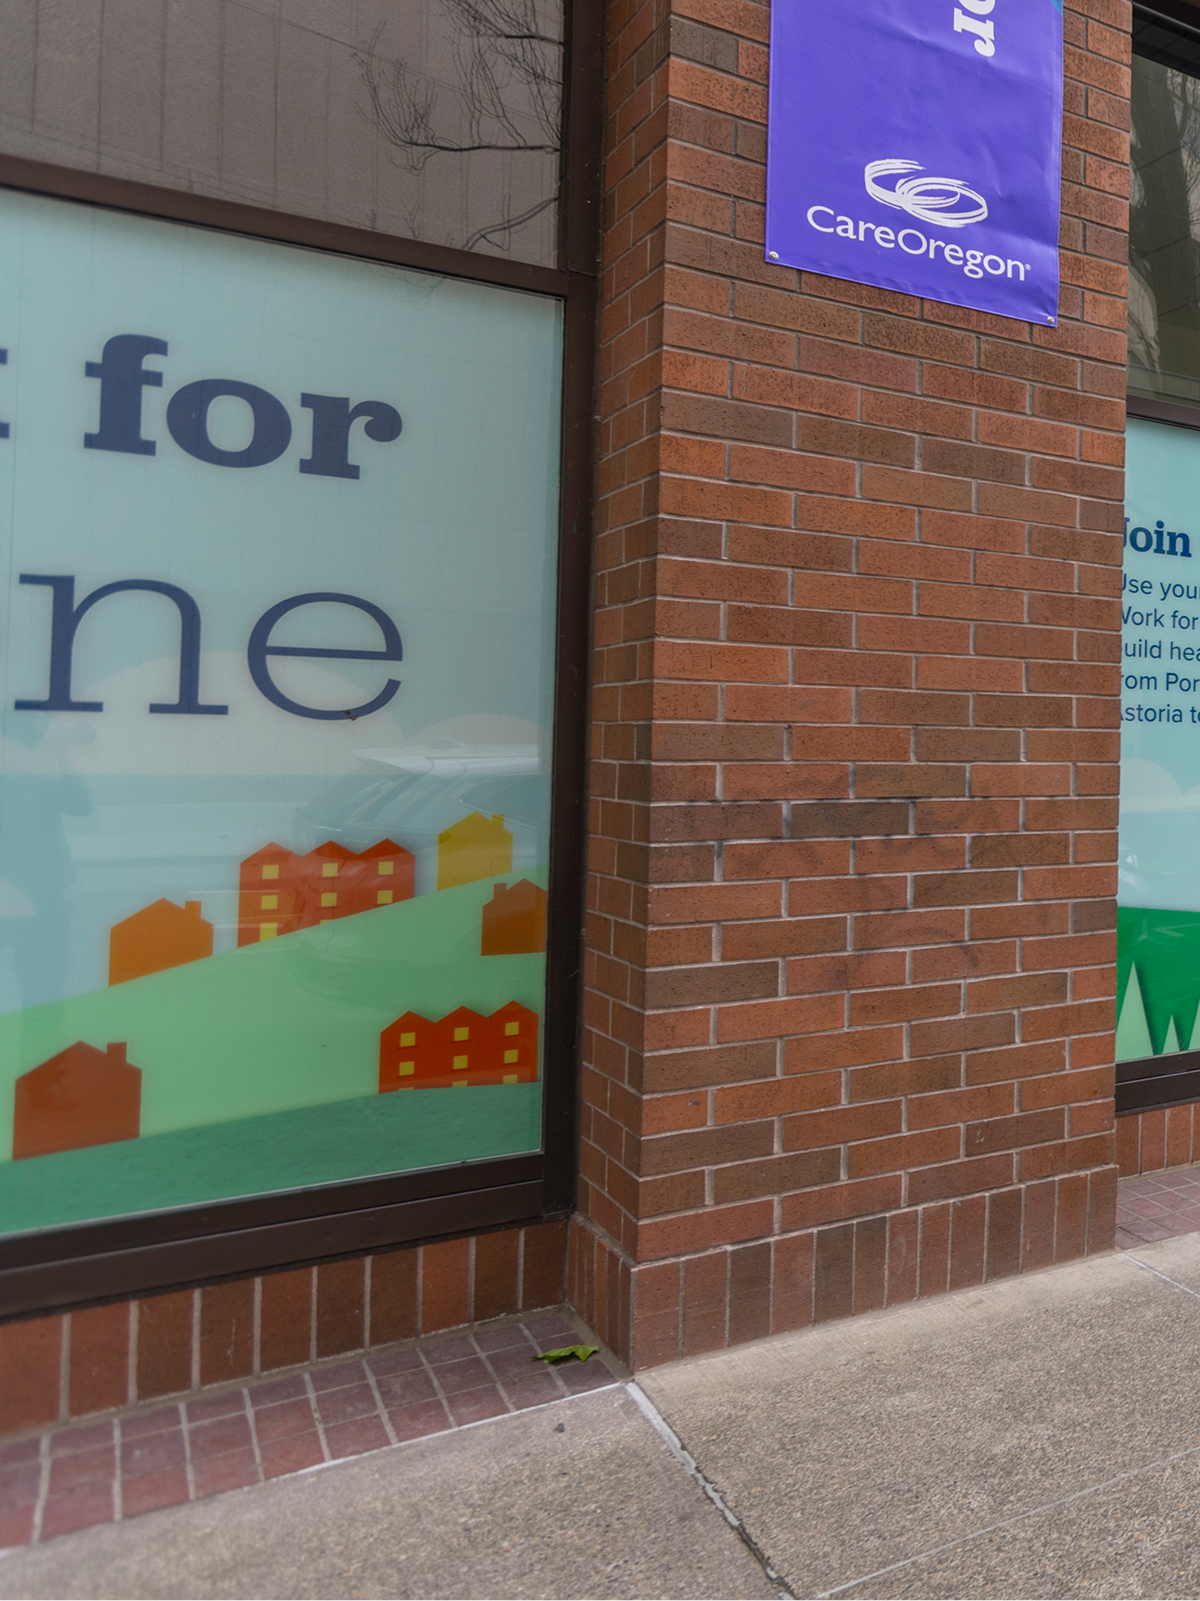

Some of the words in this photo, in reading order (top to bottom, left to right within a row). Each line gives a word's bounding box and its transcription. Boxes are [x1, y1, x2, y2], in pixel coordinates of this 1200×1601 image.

[84, 334, 403, 480] for
[1171, 610, 1199, 630] for
[14, 574, 403, 721] ne
[1124, 639, 1162, 659] uild
[1120, 704, 1183, 723] storia
